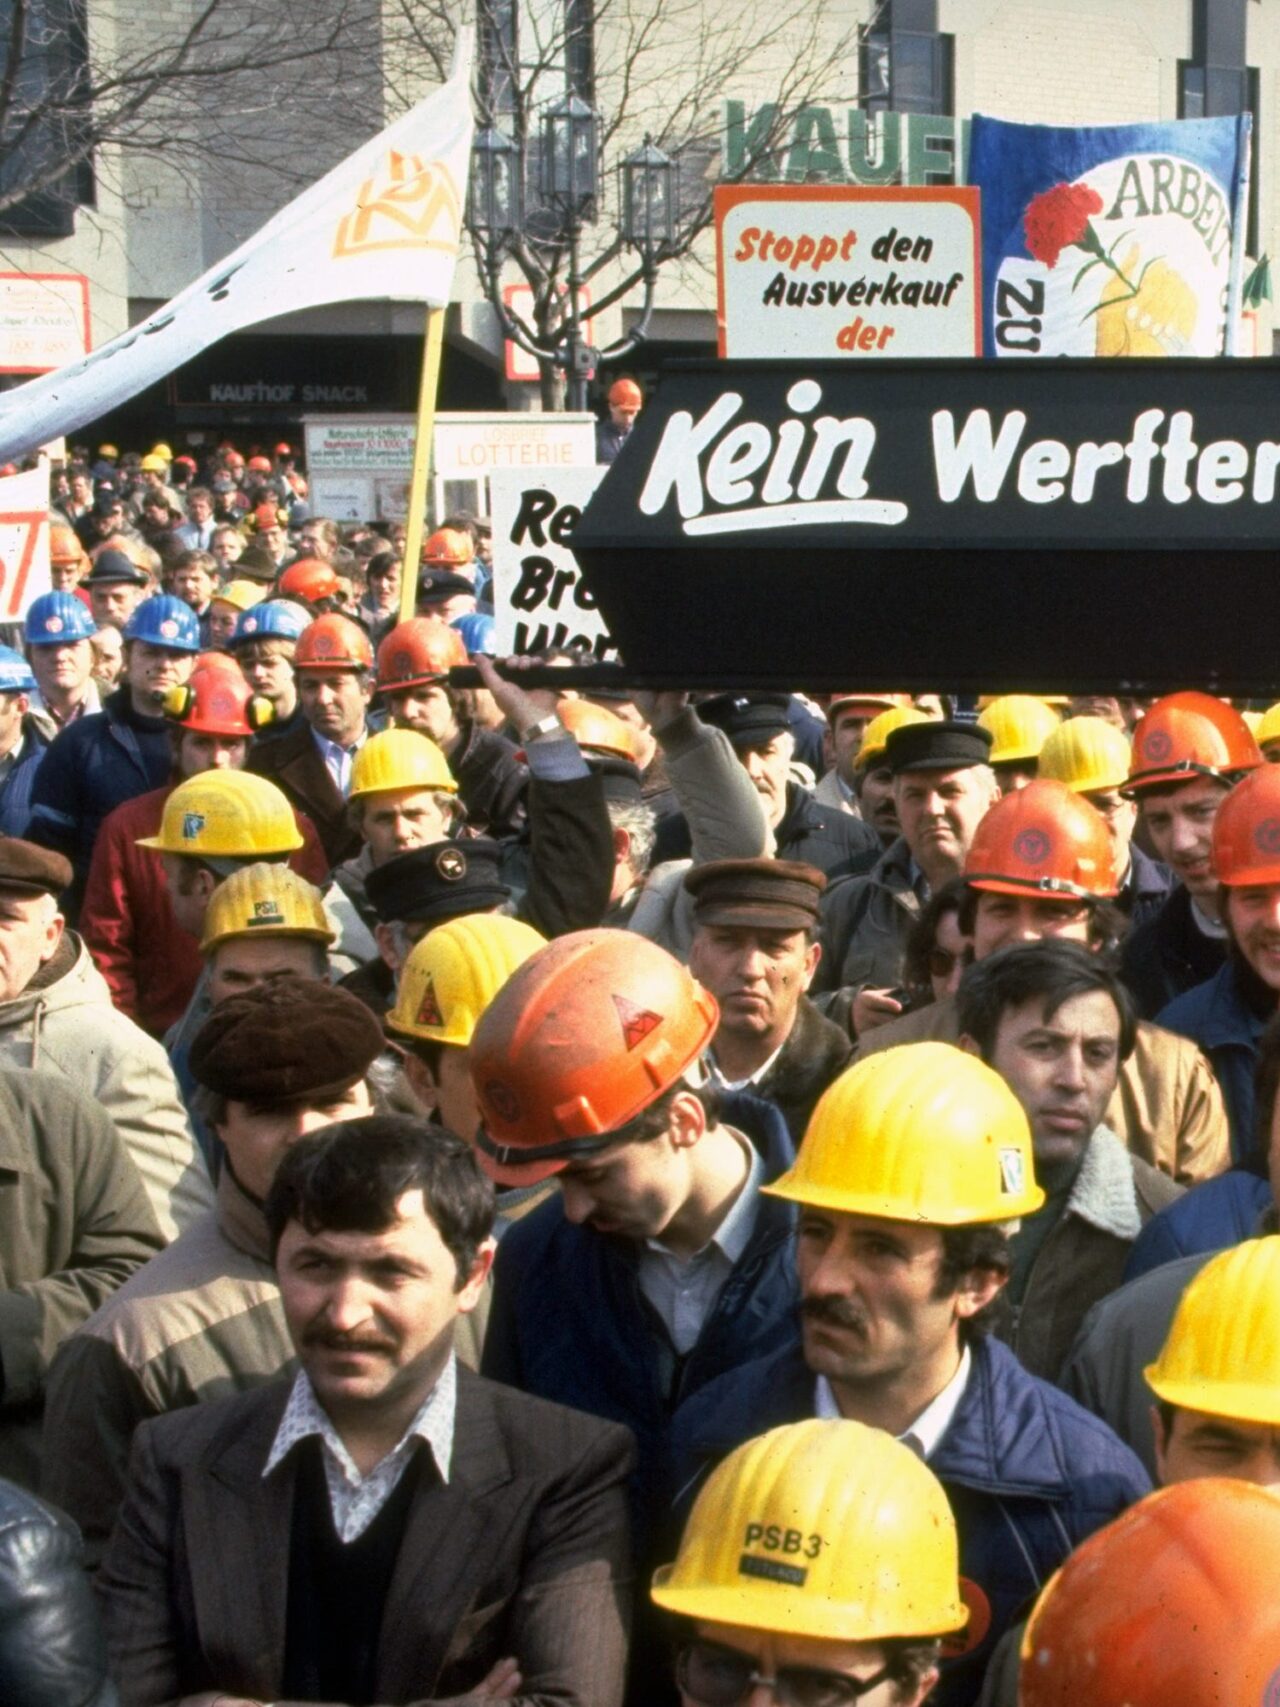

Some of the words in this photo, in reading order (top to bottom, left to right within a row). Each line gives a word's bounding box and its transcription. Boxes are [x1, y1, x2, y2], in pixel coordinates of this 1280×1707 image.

[735, 227, 857, 271] Stoppt
[871, 227, 933, 262] den
[763, 272, 963, 307] Ausverkauf
[836, 316, 894, 352] der
[302, 384, 367, 401] SNACK
[459, 443, 573, 466] LOTTERIE
[640, 379, 876, 520] Kein
